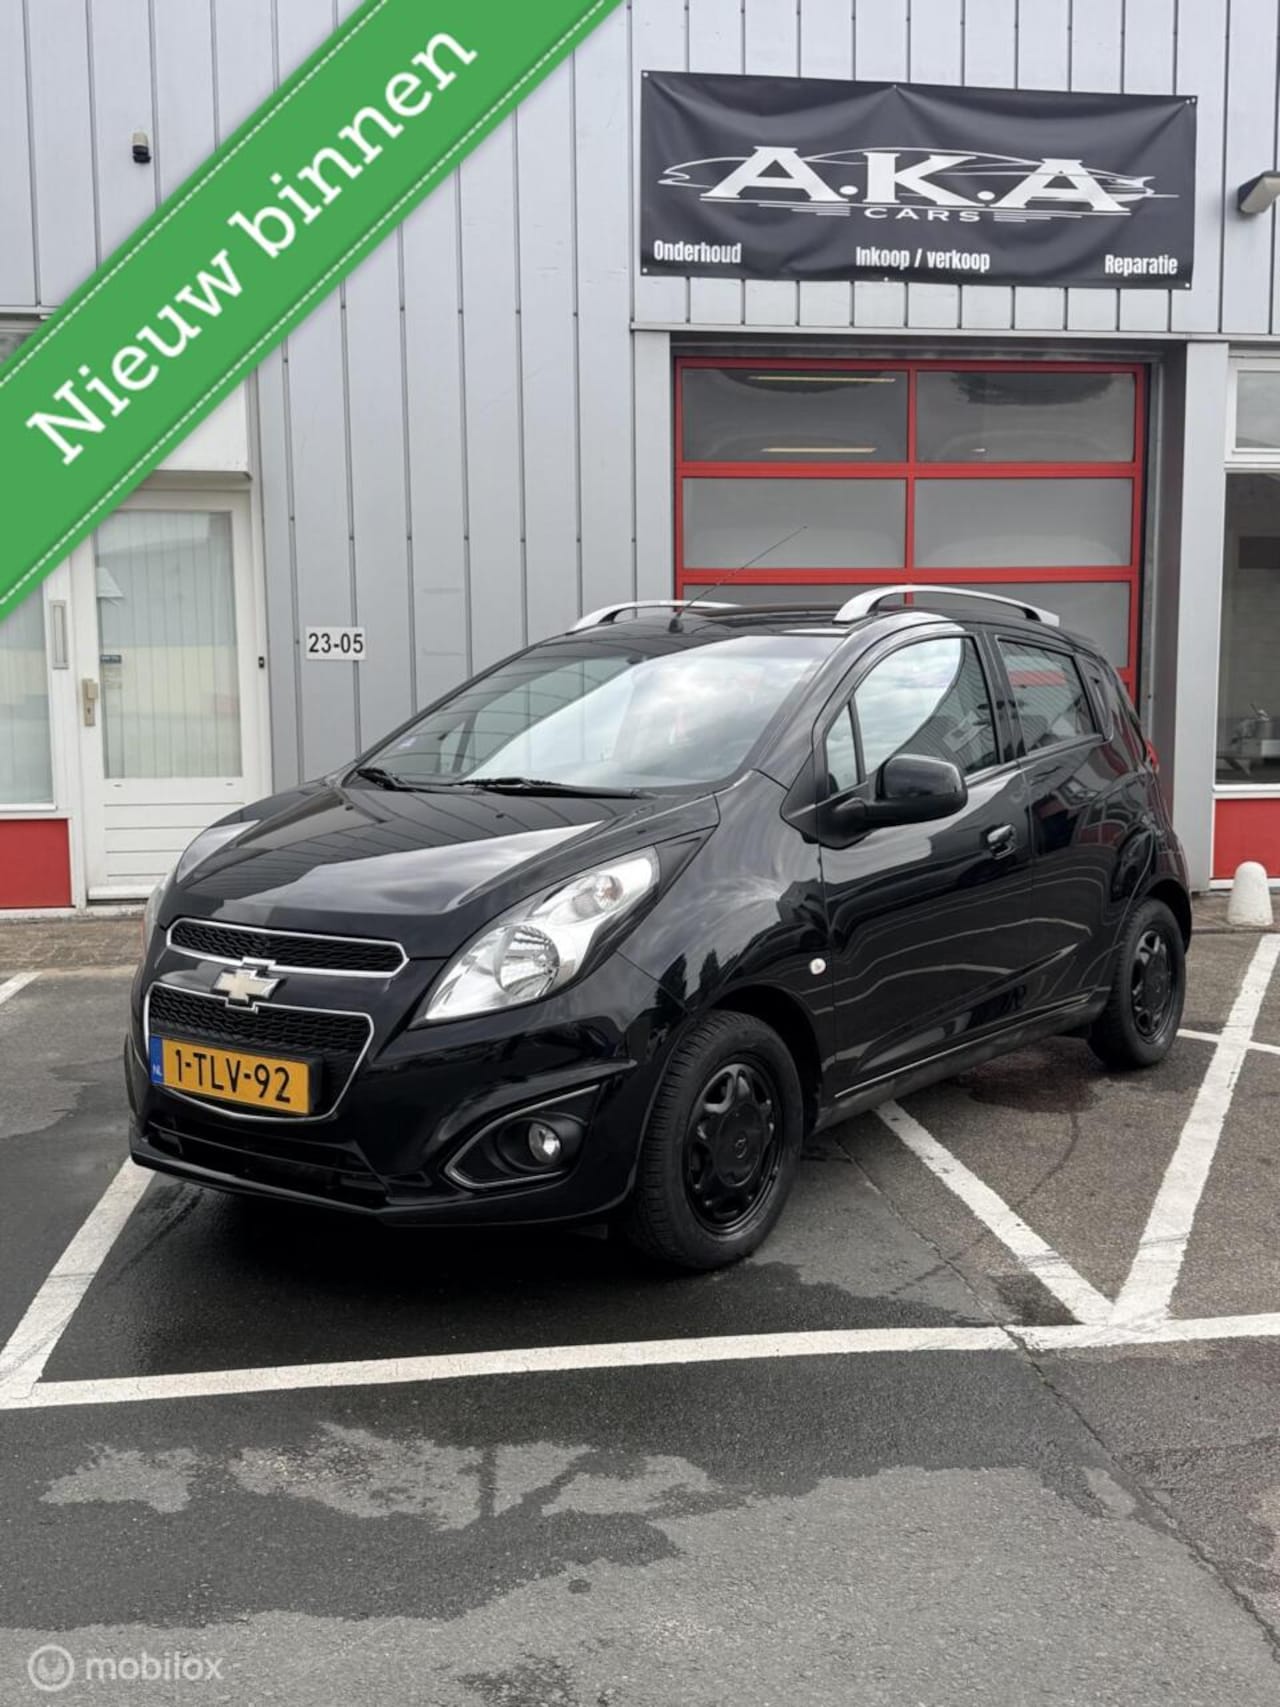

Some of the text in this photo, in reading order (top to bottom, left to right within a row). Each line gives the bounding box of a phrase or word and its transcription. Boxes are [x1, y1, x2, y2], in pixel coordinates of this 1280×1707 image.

[864, 208, 981, 222] CARS
[653, 240, 742, 263] Onderhoud
[855, 246, 990, 273] Inkoop / verkoop
[1104, 254, 1178, 276] Reparatie
[308, 632, 363, 653] 23-05
[152, 1064, 163, 1077] NL
[175, 1049, 291, 1103] 1-TLV-92
